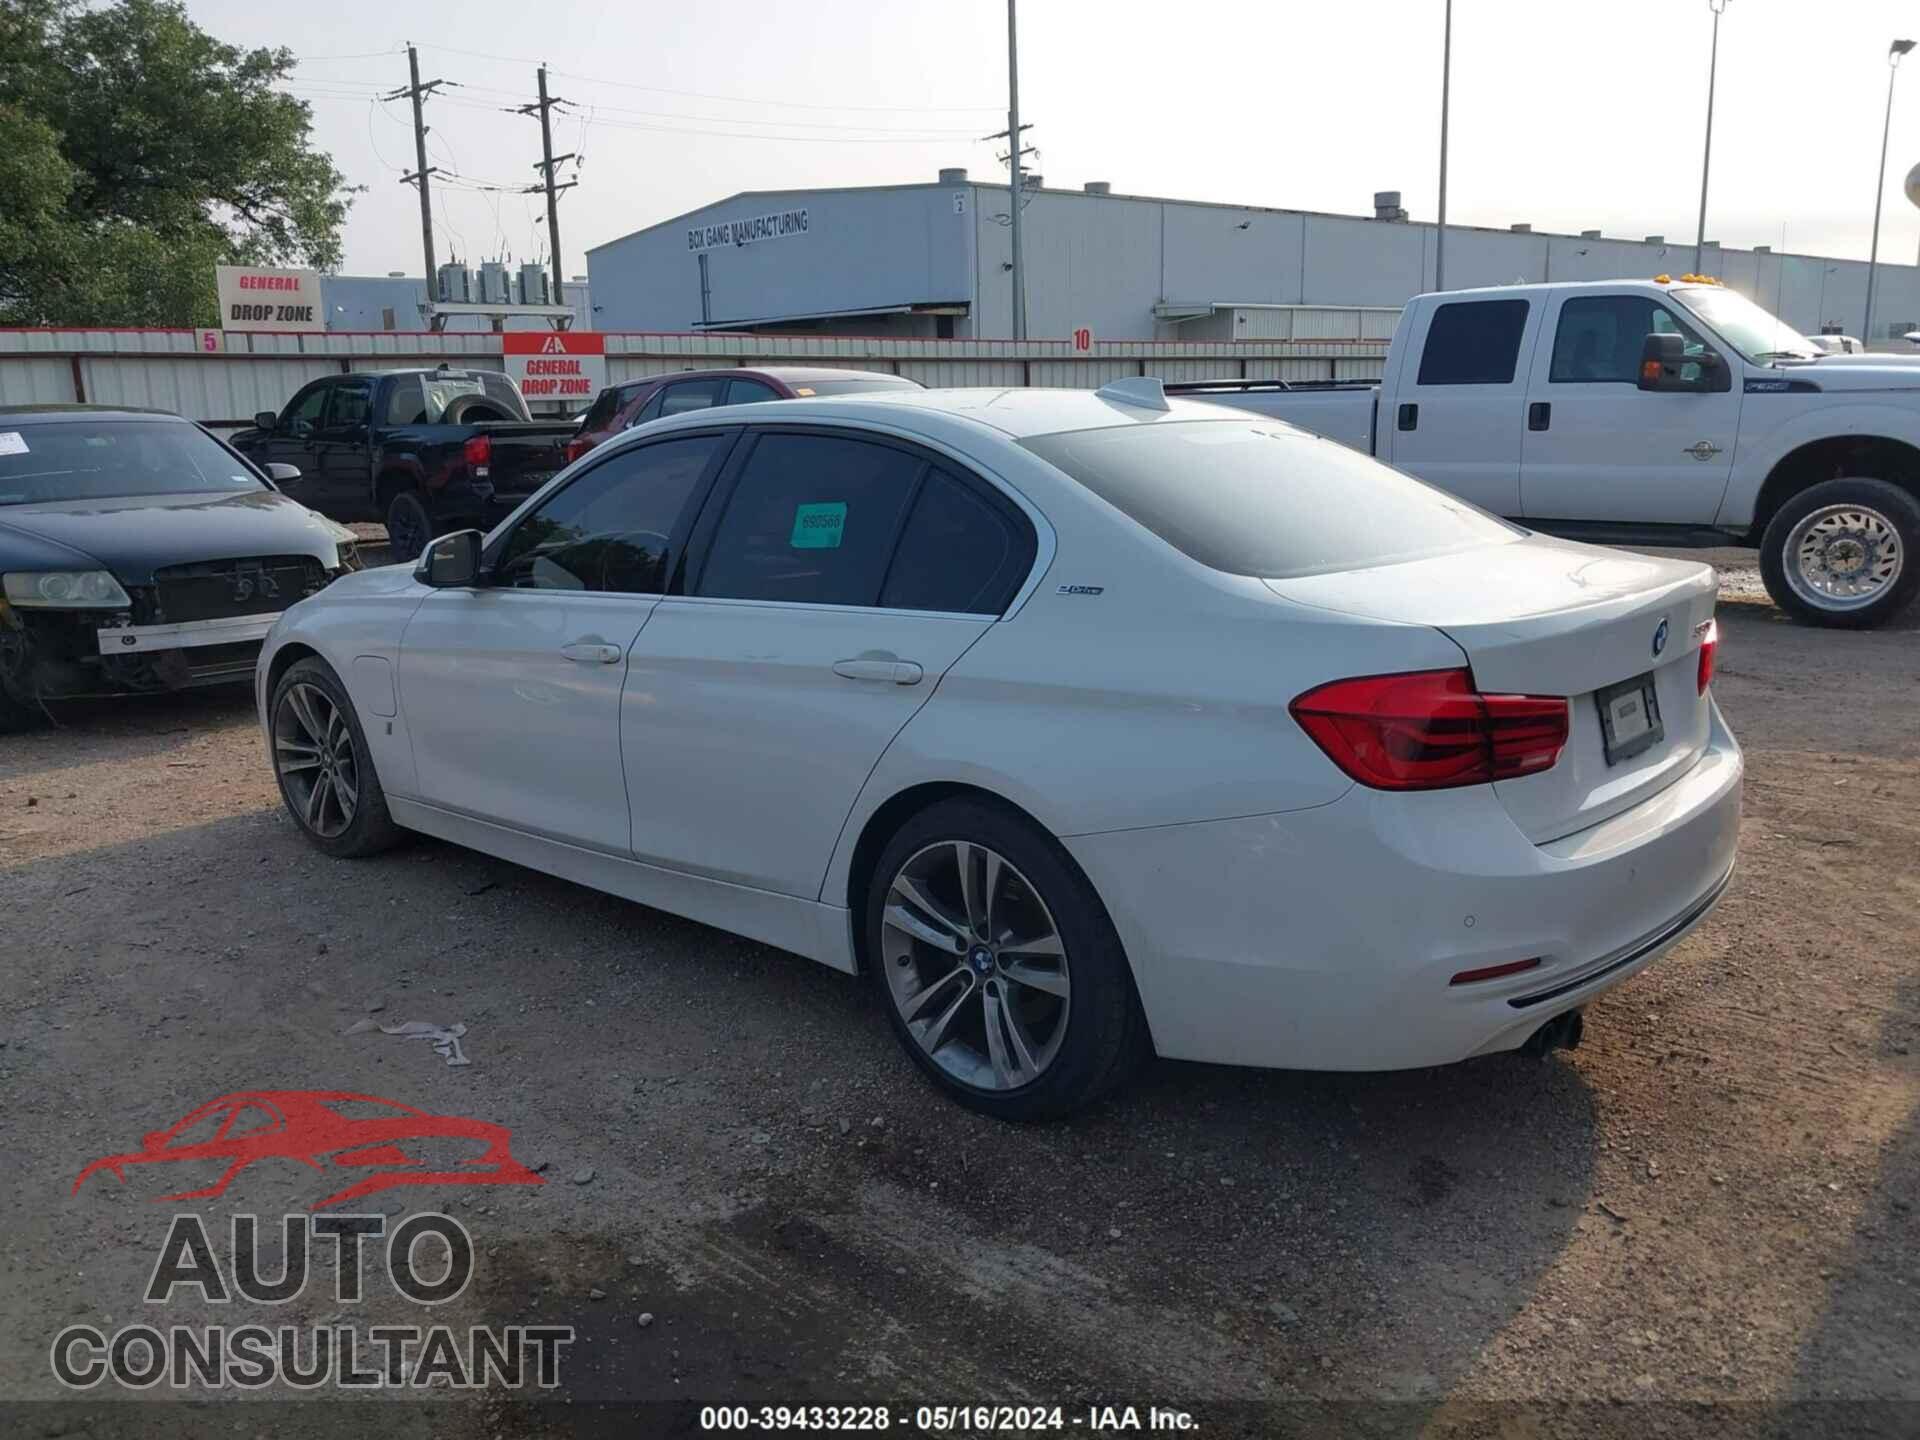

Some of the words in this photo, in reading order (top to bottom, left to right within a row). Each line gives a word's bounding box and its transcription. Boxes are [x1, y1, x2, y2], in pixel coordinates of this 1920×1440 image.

[706, 223, 729, 247] GANG
[731, 209, 808, 244] MANUFACTURING
[240, 276, 300, 291] GENERAL
[231, 304, 273, 321] DROP
[276, 305, 313, 322] ZONE
[204, 332, 216, 351] 5
[1074, 329, 1090, 351] 10
[526, 360, 582, 375] GENERAL
[522, 379, 557, 395] DROP
[559, 379, 592, 394] ZONE
